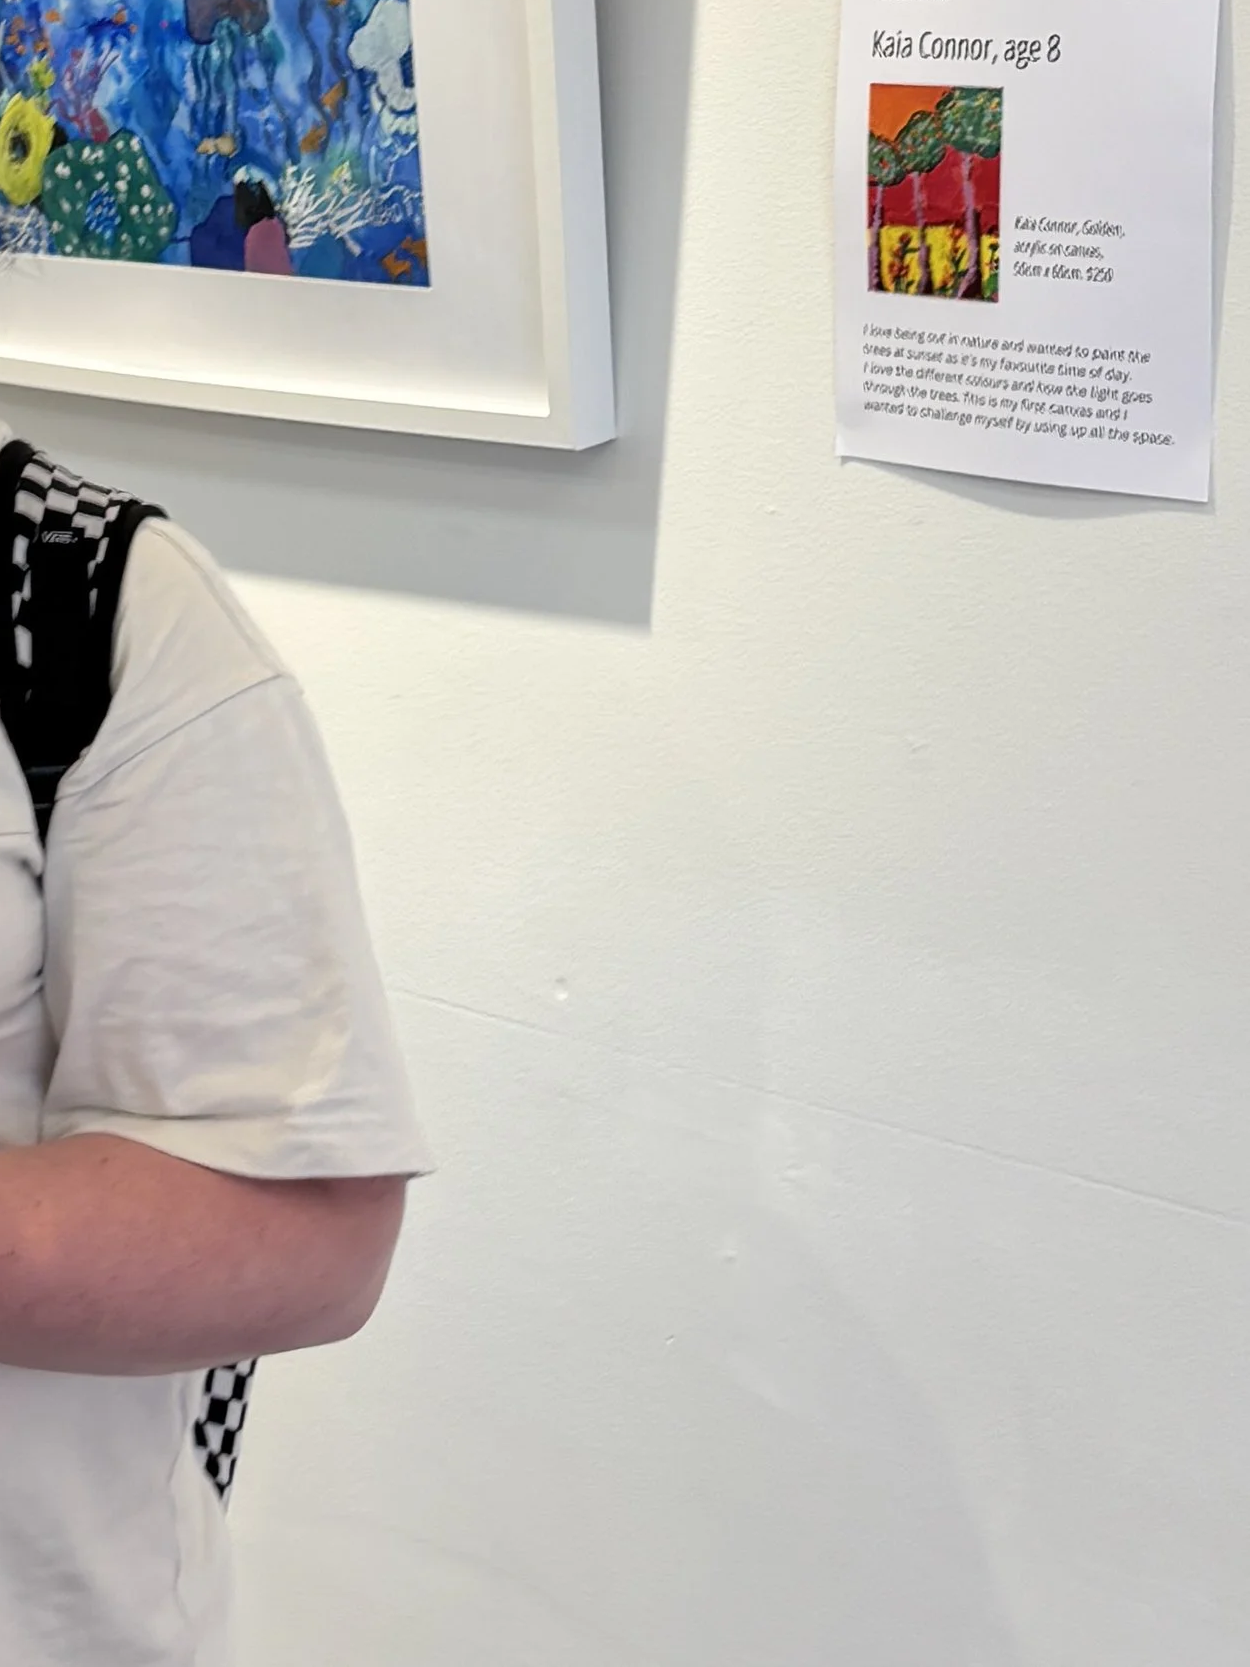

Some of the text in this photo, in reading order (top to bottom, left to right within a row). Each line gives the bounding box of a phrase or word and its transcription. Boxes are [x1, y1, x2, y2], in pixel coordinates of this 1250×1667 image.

[872, 30, 1061, 70] Kaia Connor, age 8
[1048, 242, 1063, 257] on
[863, 342, 892, 358] trees
[893, 346, 905, 359] at
[906, 348, 944, 364] sunset
[945, 352, 959, 366] as
[979, 356, 998, 372] my
[999, 357, 1055, 376] favourite
[1058, 362, 1087, 378] time
[1088, 366, 1103, 379] of
[870, 323, 892, 338] love
[893, 327, 925, 345] being
[926, 331, 947, 345] out
[948, 331, 959, 345] in
[960, 334, 999, 350] nature
[1001, 338, 1025, 353] and
[1026, 342, 1073, 358] wanted
[1075, 345, 1090, 359] to
[1091, 346, 1125, 362] paint
[1128, 349, 1151, 364] the
[863, 380, 905, 398] through
[906, 385, 928, 399] the
[961, 391, 986, 407] This
[988, 394, 998, 408] is
[999, 396, 1018, 413] my
[1020, 397, 1046, 415] first
[1049, 402, 1094, 419] canvas
[1095, 407, 1121, 421] and
[870, 361, 893, 376] love
[895, 365, 914, 379] the
[915, 367, 965, 385] different
[965, 372, 1009, 390] colours
[1010, 379, 1035, 393] and
[1035, 380, 1063, 395] how
[1065, 384, 1087, 399] the
[1090, 385, 1119, 402] light
[1121, 390, 1153, 405] goes
[863, 401, 905, 416] wanted
[906, 404, 918, 417] to
[919, 406, 973, 426] challenge
[973, 413, 1014, 430] myself
[1015, 416, 1032, 434] by
[1033, 420, 1068, 439] using
[1070, 424, 1087, 440] up
[1088, 425, 1105, 439] all
[1107, 427, 1130, 442] the
